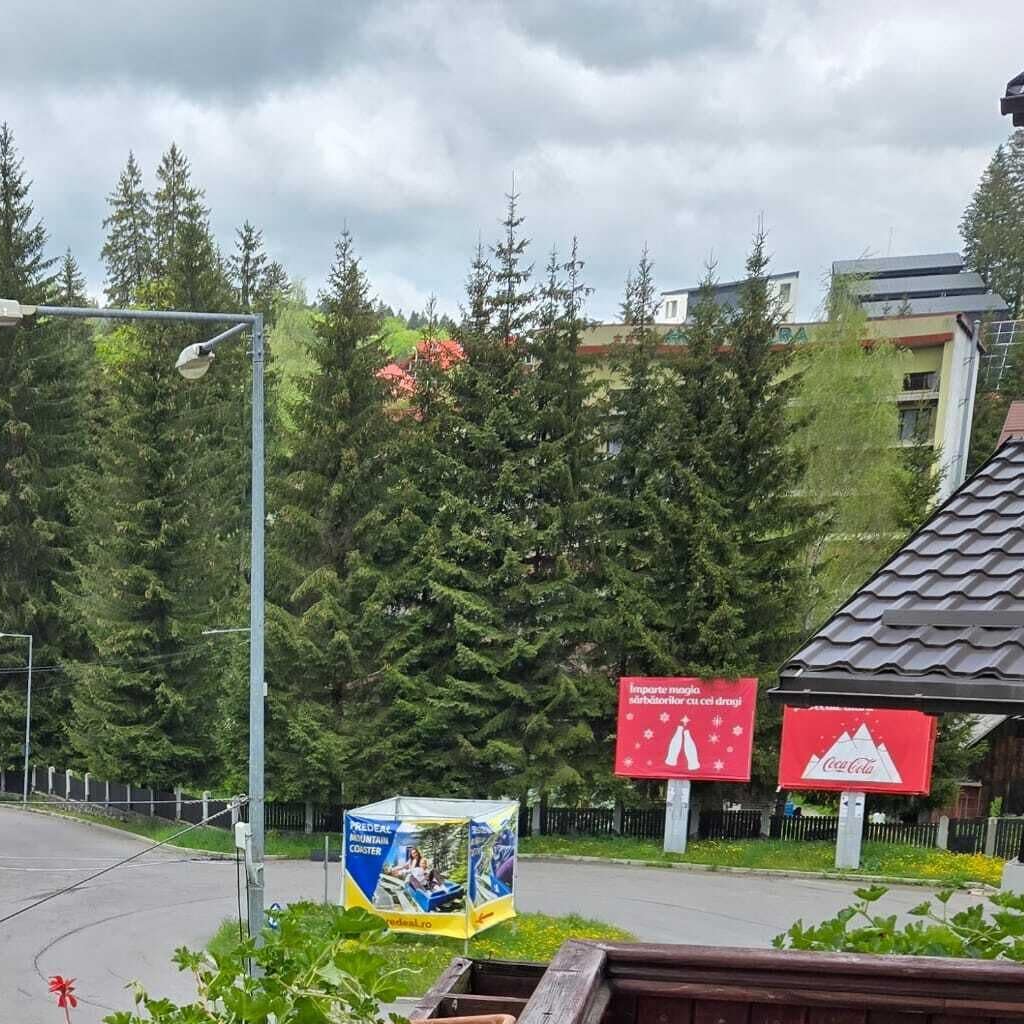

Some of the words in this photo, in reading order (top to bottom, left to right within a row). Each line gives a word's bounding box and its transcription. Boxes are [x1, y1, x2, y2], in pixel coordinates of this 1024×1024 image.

[668, 684, 700, 697] magia
[686, 698, 698, 706] cu
[700, 696, 714, 706] cei
[715, 697, 742, 708] dragi
[822, 756, 876, 775] Coca-Cola
[350, 820, 392, 834] PREDEAL
